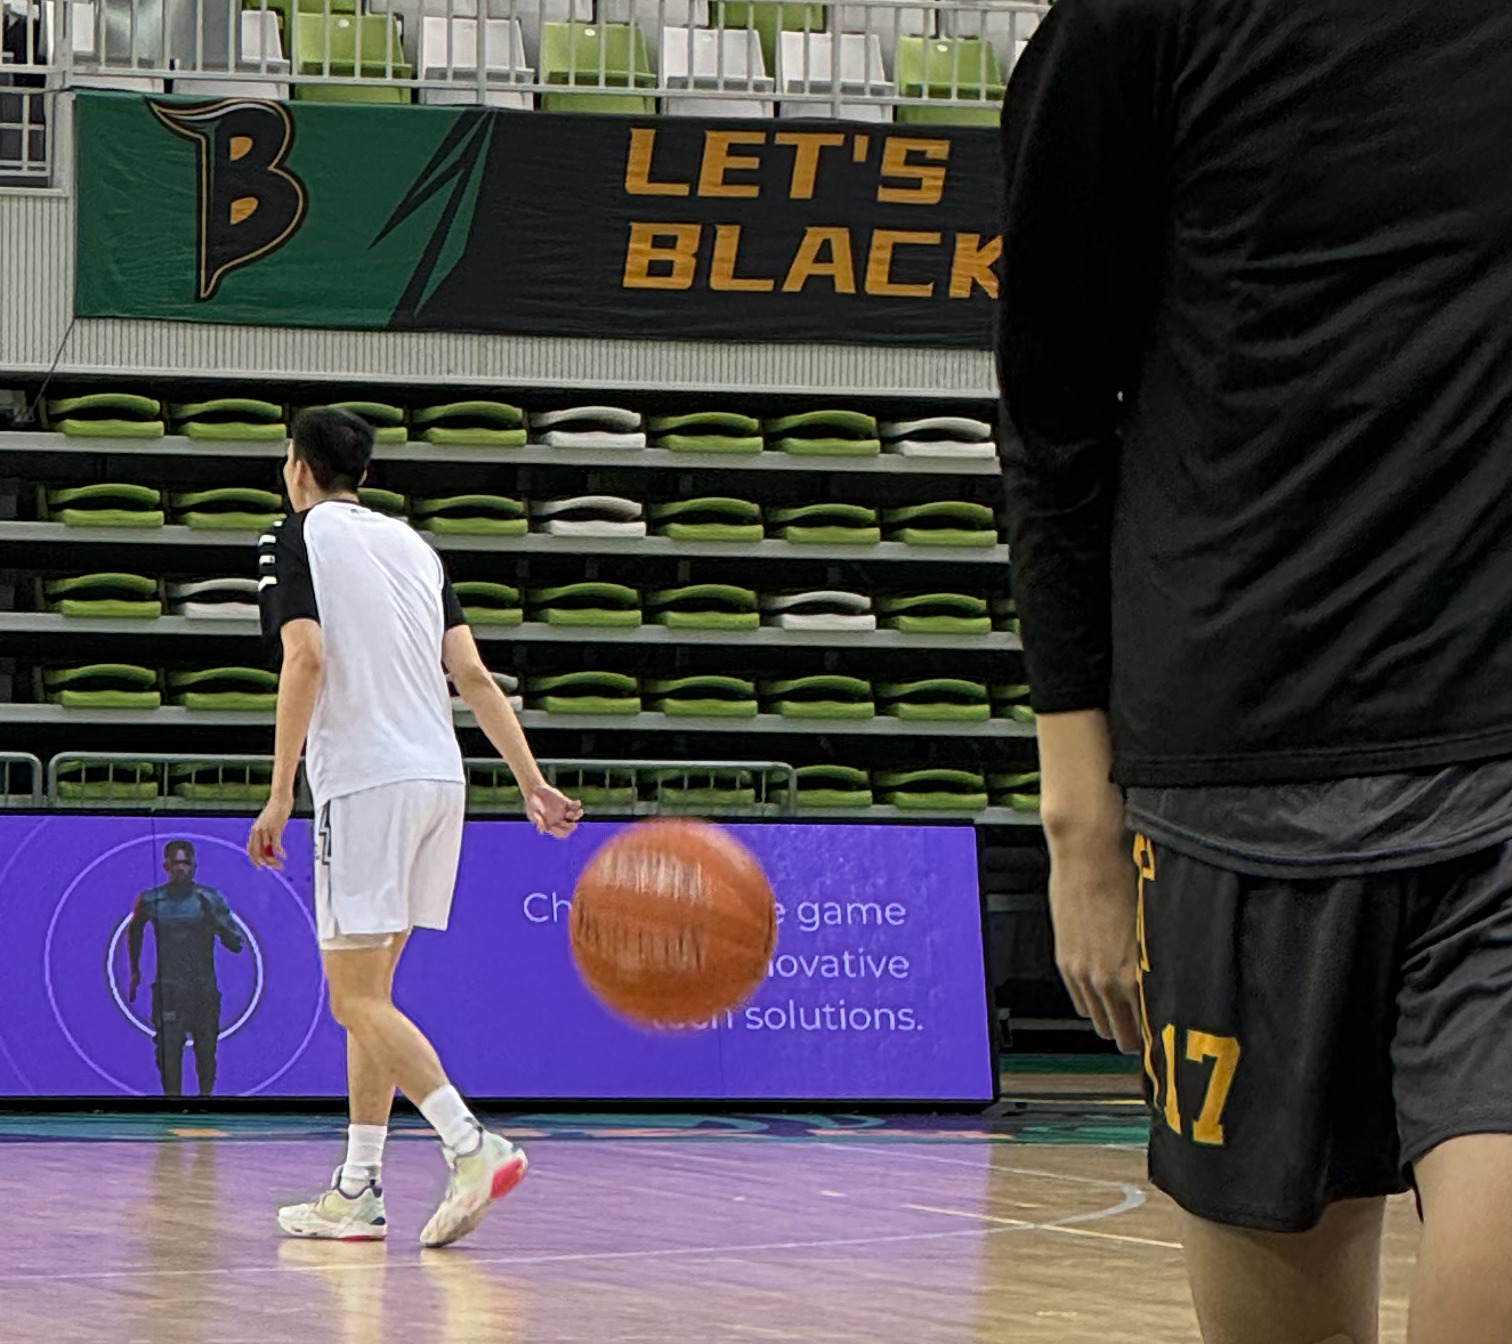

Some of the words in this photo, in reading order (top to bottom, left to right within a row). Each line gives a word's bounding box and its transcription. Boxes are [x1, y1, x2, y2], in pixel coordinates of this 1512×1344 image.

[625, 128, 951, 205] LET'S
[623, 222, 1002, 300] BLACK
[797, 901, 907, 932] game
[766, 947, 911, 979] ovative
[744, 999, 925, 1032] solutions.
[1160, 1022, 1242, 1145] 17
